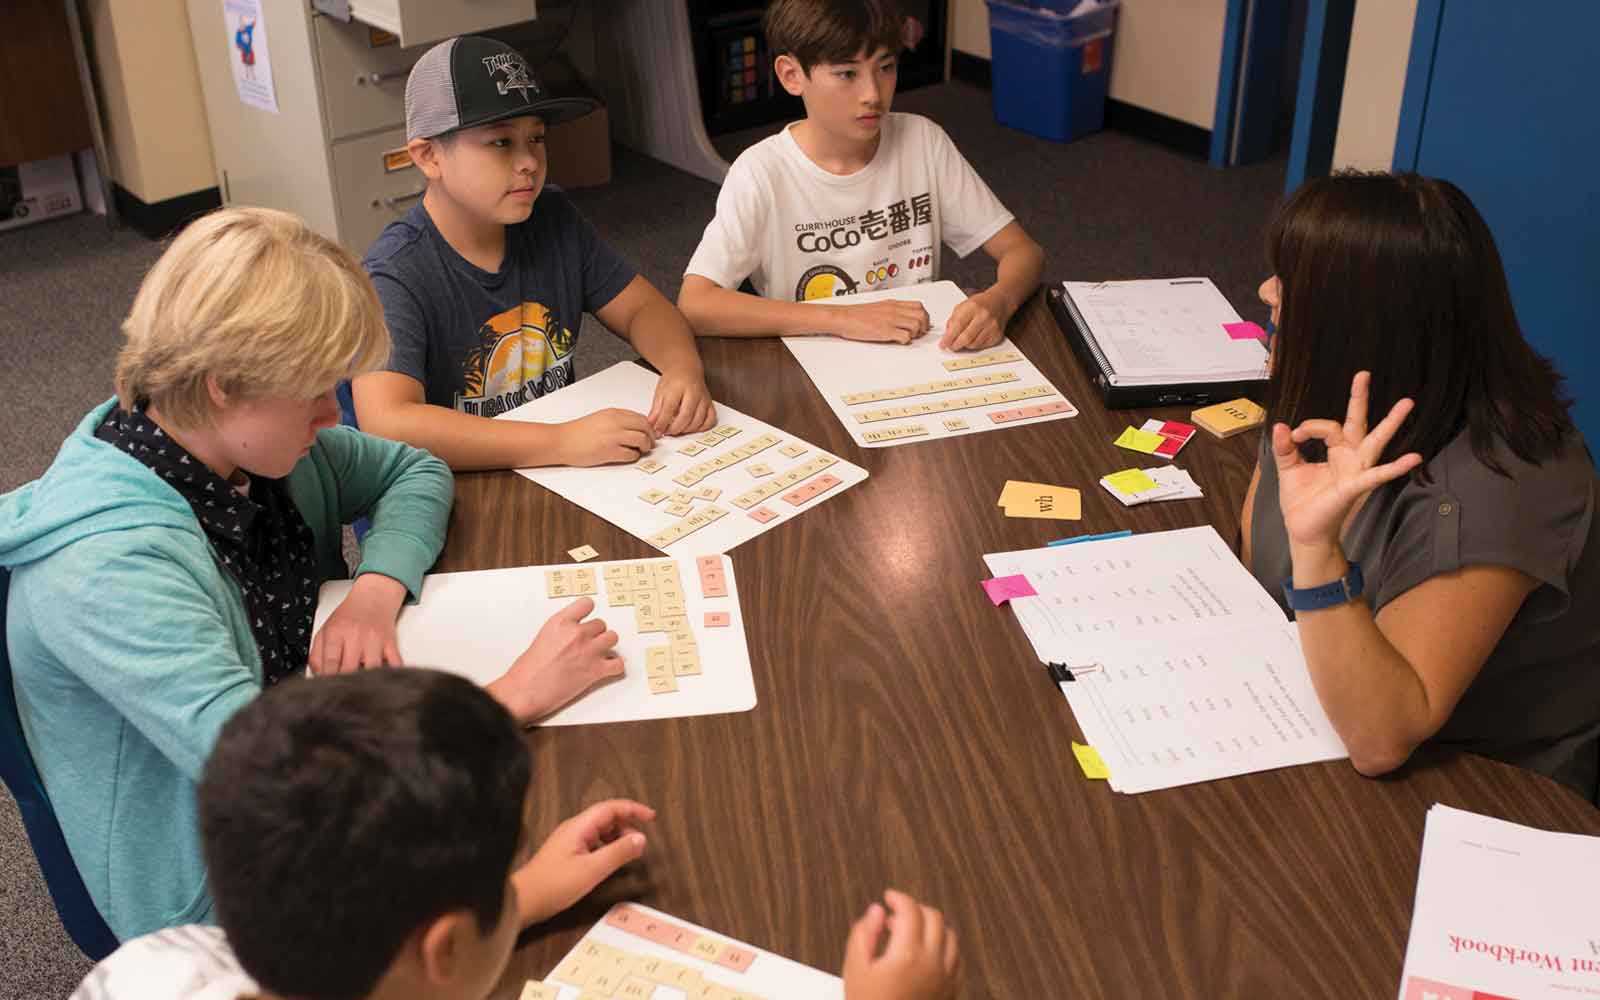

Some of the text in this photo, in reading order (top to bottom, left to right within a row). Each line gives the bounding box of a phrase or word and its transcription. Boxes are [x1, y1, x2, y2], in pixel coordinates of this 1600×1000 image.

[824, 215, 856, 229] HOUSE
[1034, 495, 1053, 513] wh
[1449, 934, 1562, 972] Workbook
